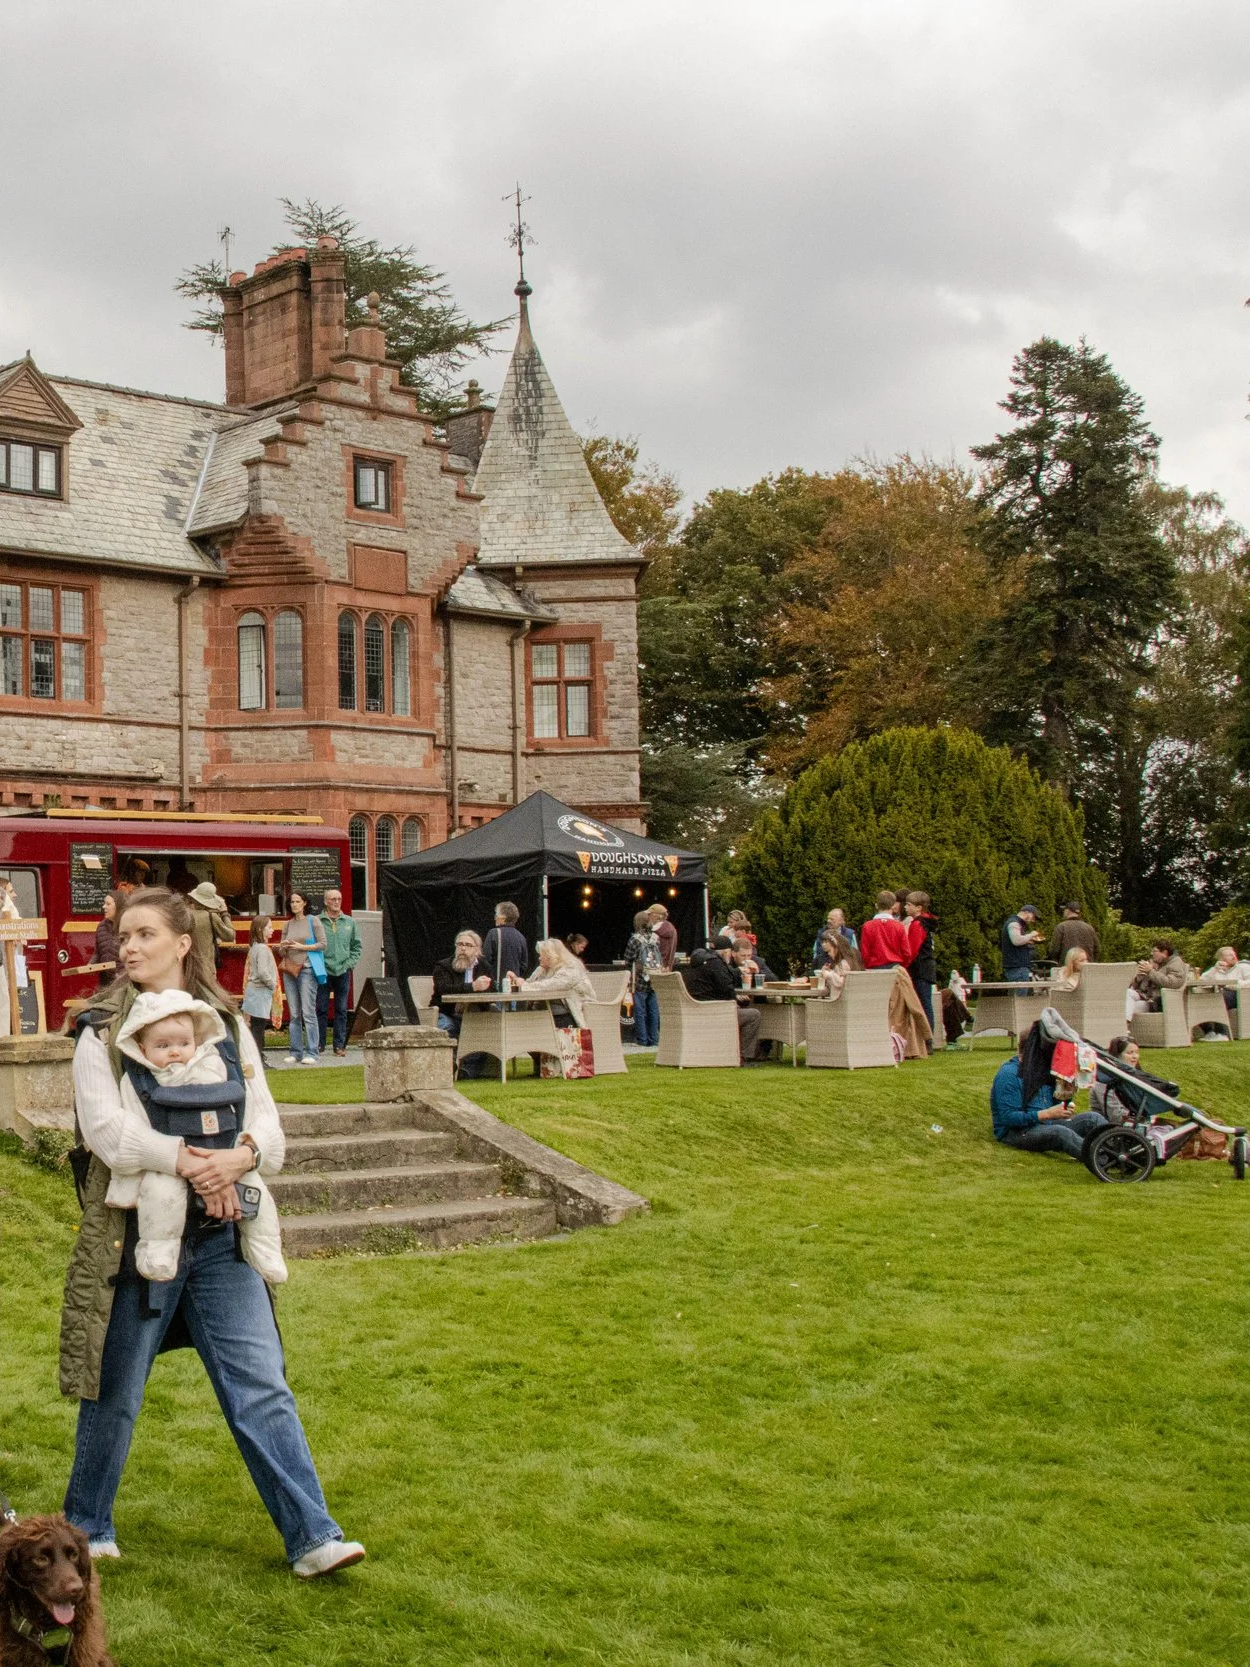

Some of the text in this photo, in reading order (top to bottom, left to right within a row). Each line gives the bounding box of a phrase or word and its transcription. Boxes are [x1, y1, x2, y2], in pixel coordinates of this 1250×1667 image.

[591, 851, 666, 866] DOUGHSON'S
[591, 865, 666, 877] HANDMADE PIZZA
[19, 930, 39, 940] Stalls
